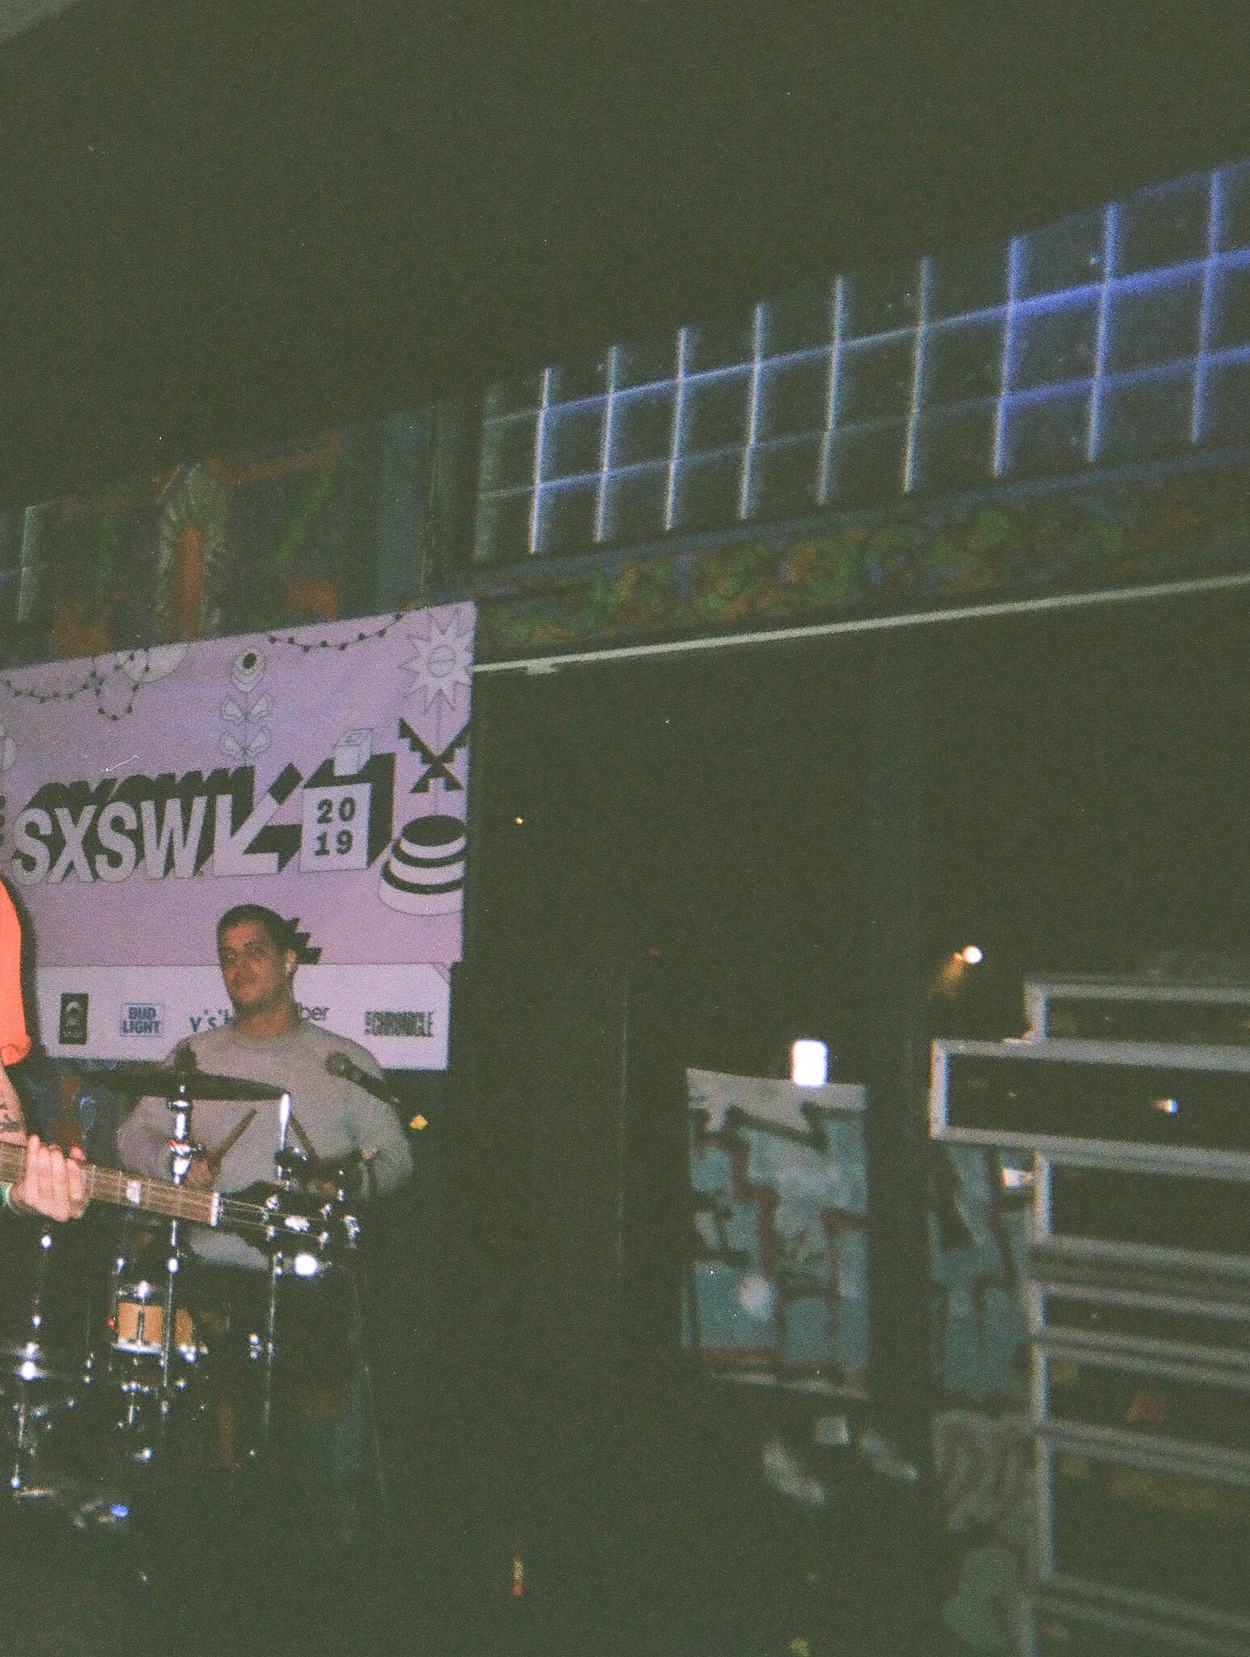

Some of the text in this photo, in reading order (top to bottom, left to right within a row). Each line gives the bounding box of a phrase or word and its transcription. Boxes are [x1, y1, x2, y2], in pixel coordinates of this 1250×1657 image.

[11, 792, 210, 886] SXSW
[128, 1006, 157, 1020] BUD
[297, 1002, 330, 1021] ber
[121, 1020, 162, 1034] LIGHT
